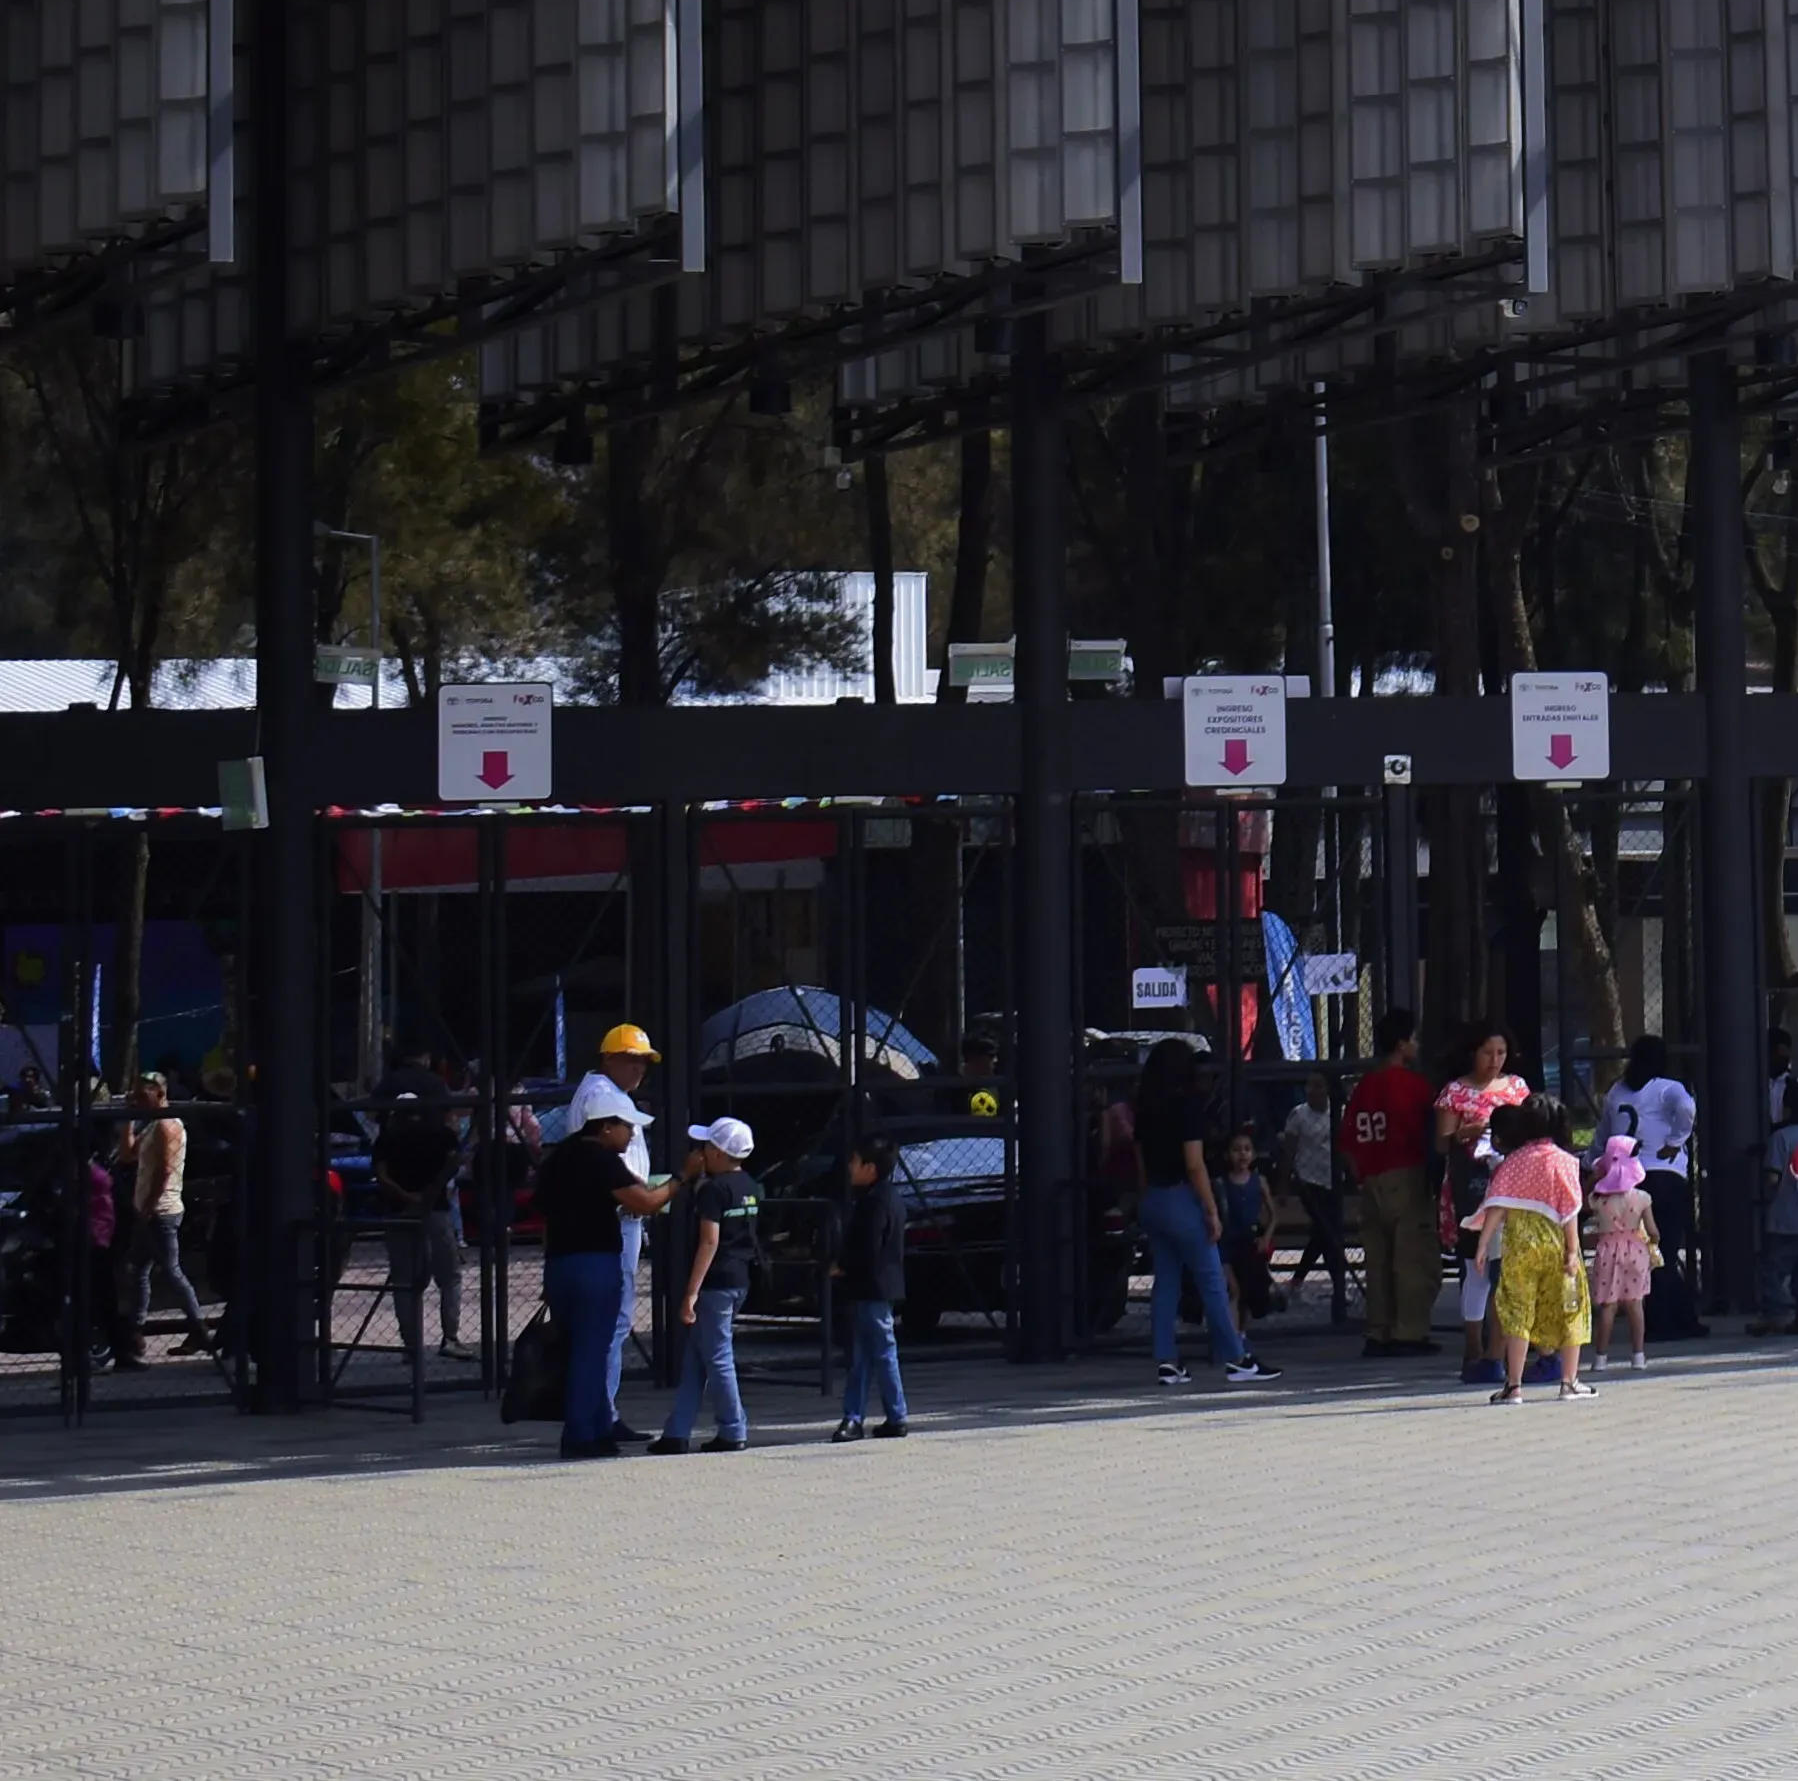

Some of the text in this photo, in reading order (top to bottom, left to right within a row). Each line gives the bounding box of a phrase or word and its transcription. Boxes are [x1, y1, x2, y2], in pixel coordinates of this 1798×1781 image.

[1216, 704, 1253, 713] INGRESO
[1207, 715, 1263, 723] EXPOSITORES
[1204, 726, 1266, 735] CREDENCIALES
[1136, 981, 1178, 999] SALIDA
[1356, 1111, 1387, 1143] 92
